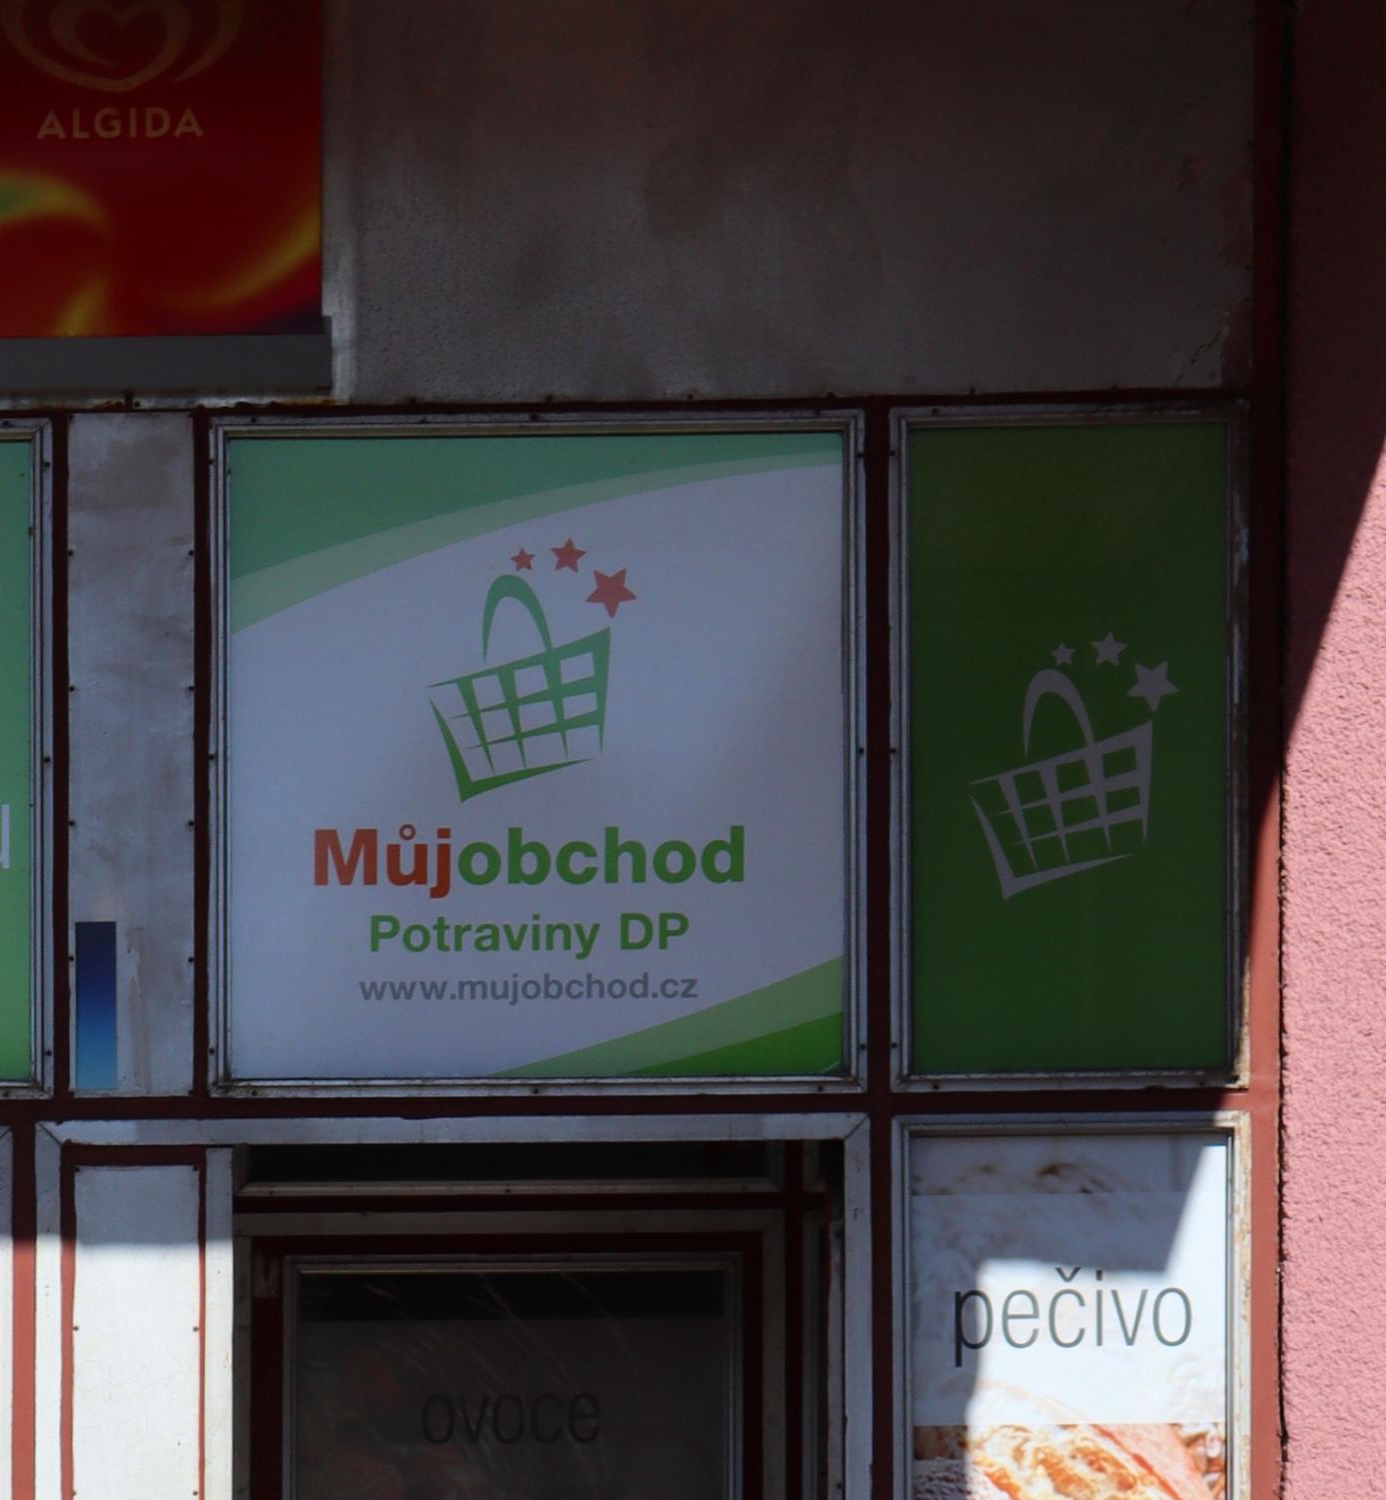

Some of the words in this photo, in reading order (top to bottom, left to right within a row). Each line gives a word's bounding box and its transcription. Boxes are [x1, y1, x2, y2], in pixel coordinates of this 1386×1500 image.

[36, 107, 204, 140] ALGIDA
[313, 823, 745, 899] Můjobchod
[369, 914, 601, 960] Potraviny
[619, 912, 690, 951] DP
[359, 973, 699, 1006] www.mujobchod.cz
[954, 1266, 1194, 1368] pečivo
[422, 1391, 602, 1444] ovoce
